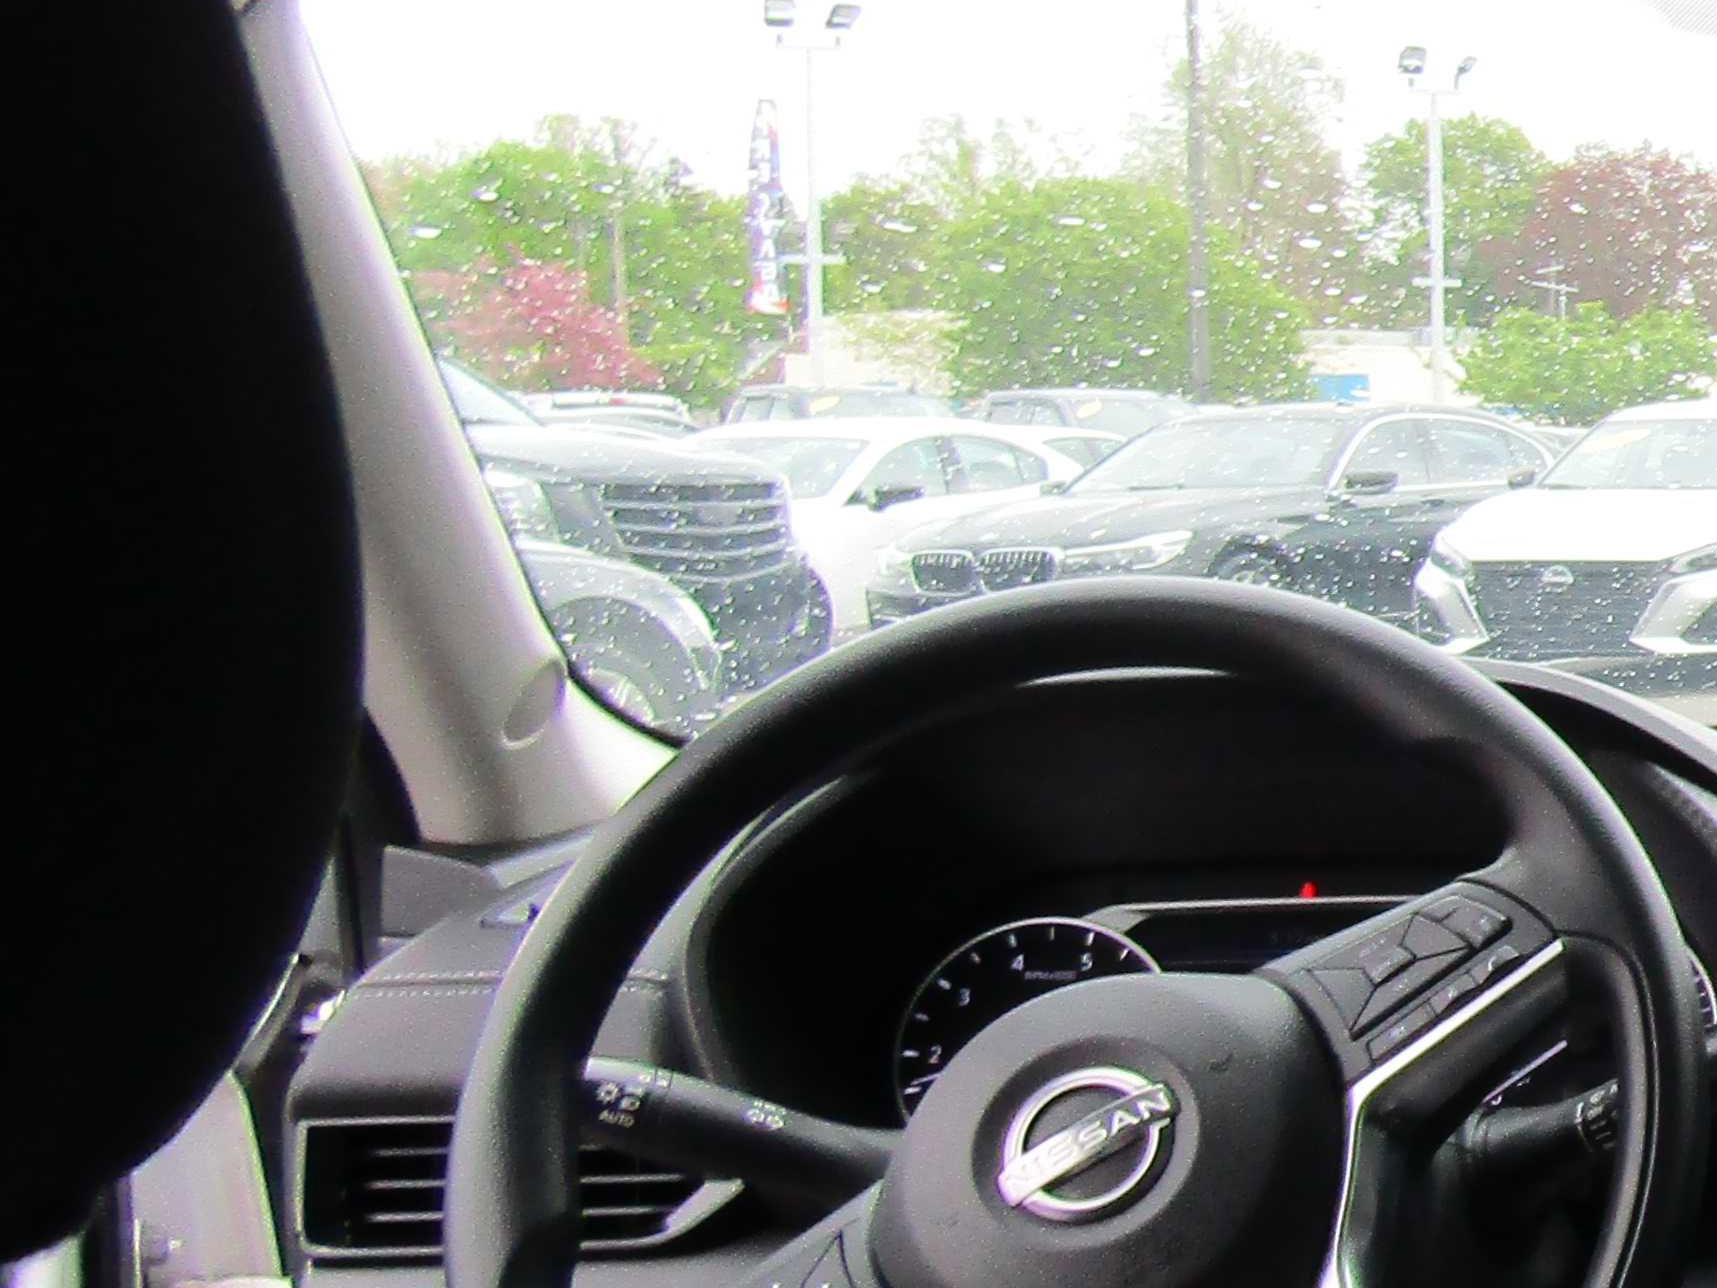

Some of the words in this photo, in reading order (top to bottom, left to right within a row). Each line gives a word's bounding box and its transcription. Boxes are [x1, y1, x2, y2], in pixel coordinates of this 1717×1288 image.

[1009, 954, 1024, 972] 4
[1081, 953, 1094, 971] 5
[958, 987, 972, 1007] 3
[928, 1045, 943, 1064] 2
[598, 1109, 636, 1129] AUTO
[1008, 1090, 1171, 1191] NISSAN
